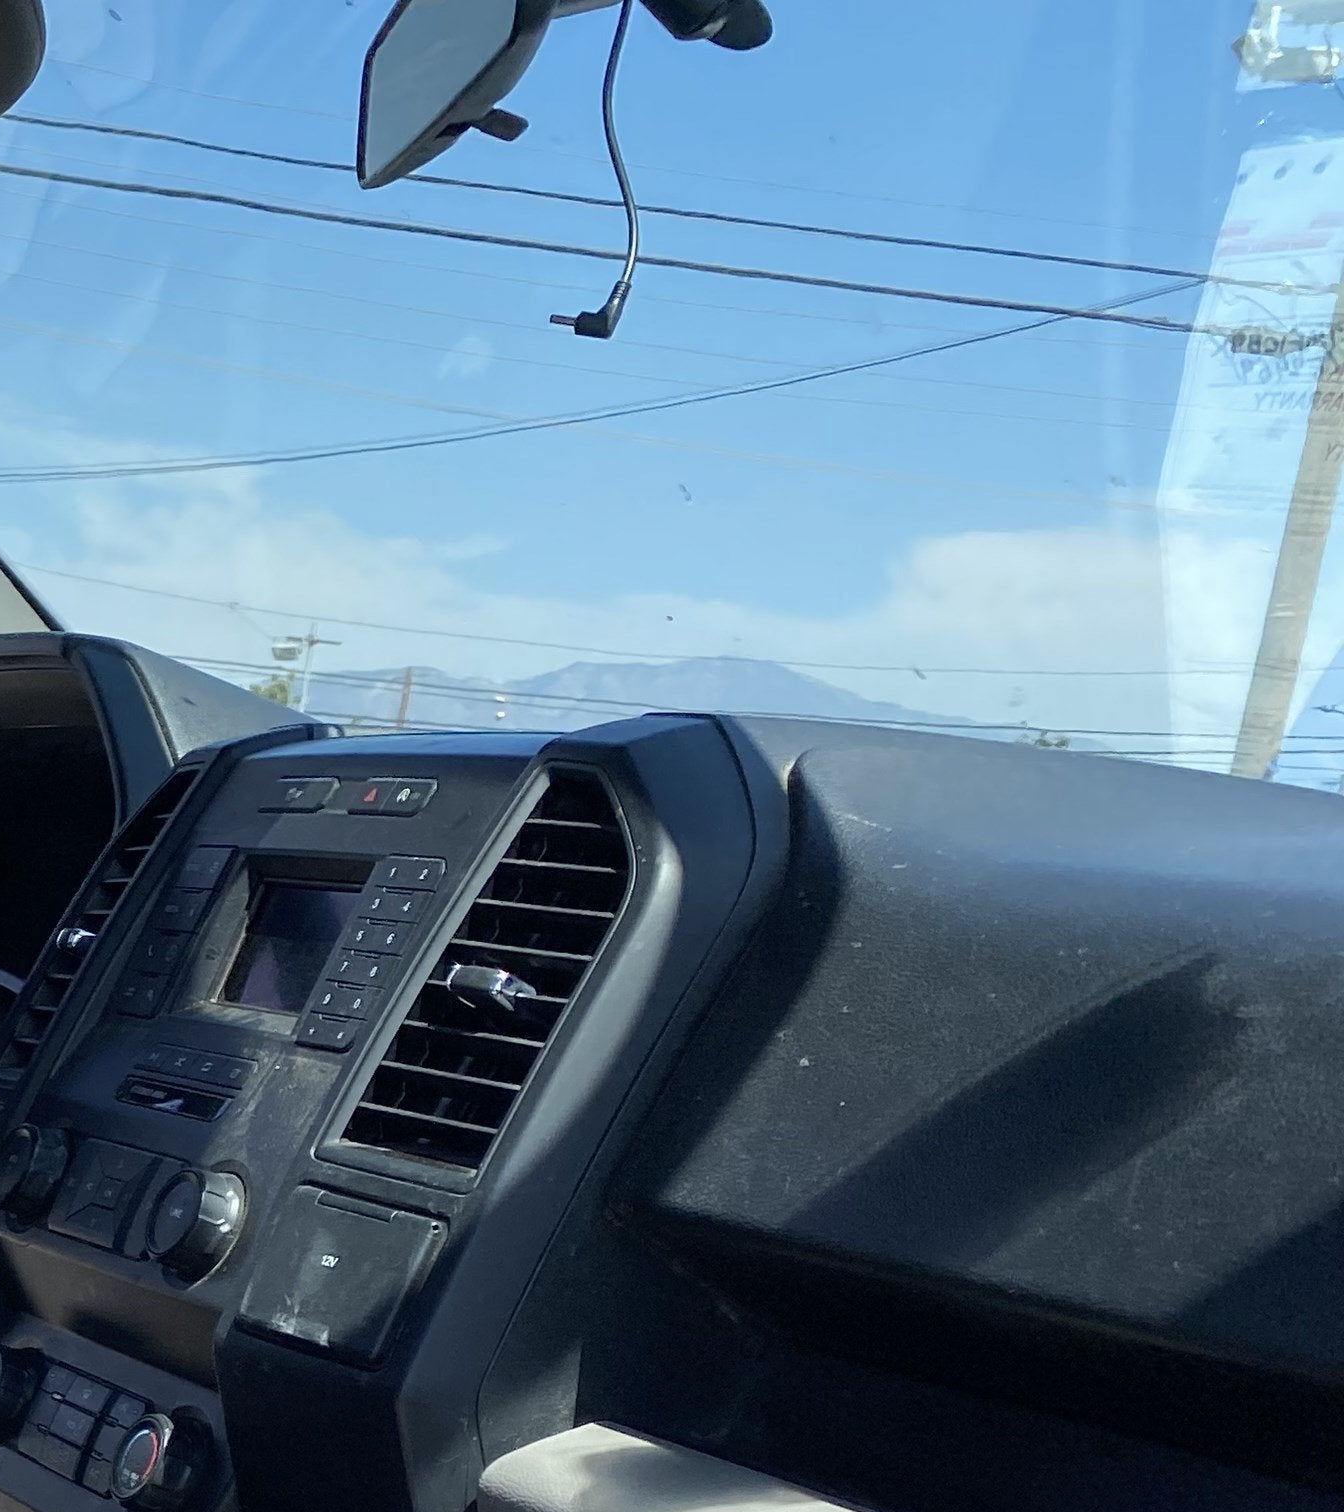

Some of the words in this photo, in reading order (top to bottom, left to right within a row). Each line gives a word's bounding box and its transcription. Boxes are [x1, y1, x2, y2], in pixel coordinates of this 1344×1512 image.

[389, 867, 398, 879] 1
[419, 868, 430, 880] 2
[371, 898, 382, 910] 3
[402, 901, 412, 913] 4
[356, 930, 365, 942] 5
[386, 933, 396, 945] 6
[321, 1255, 339, 1268] 12V
